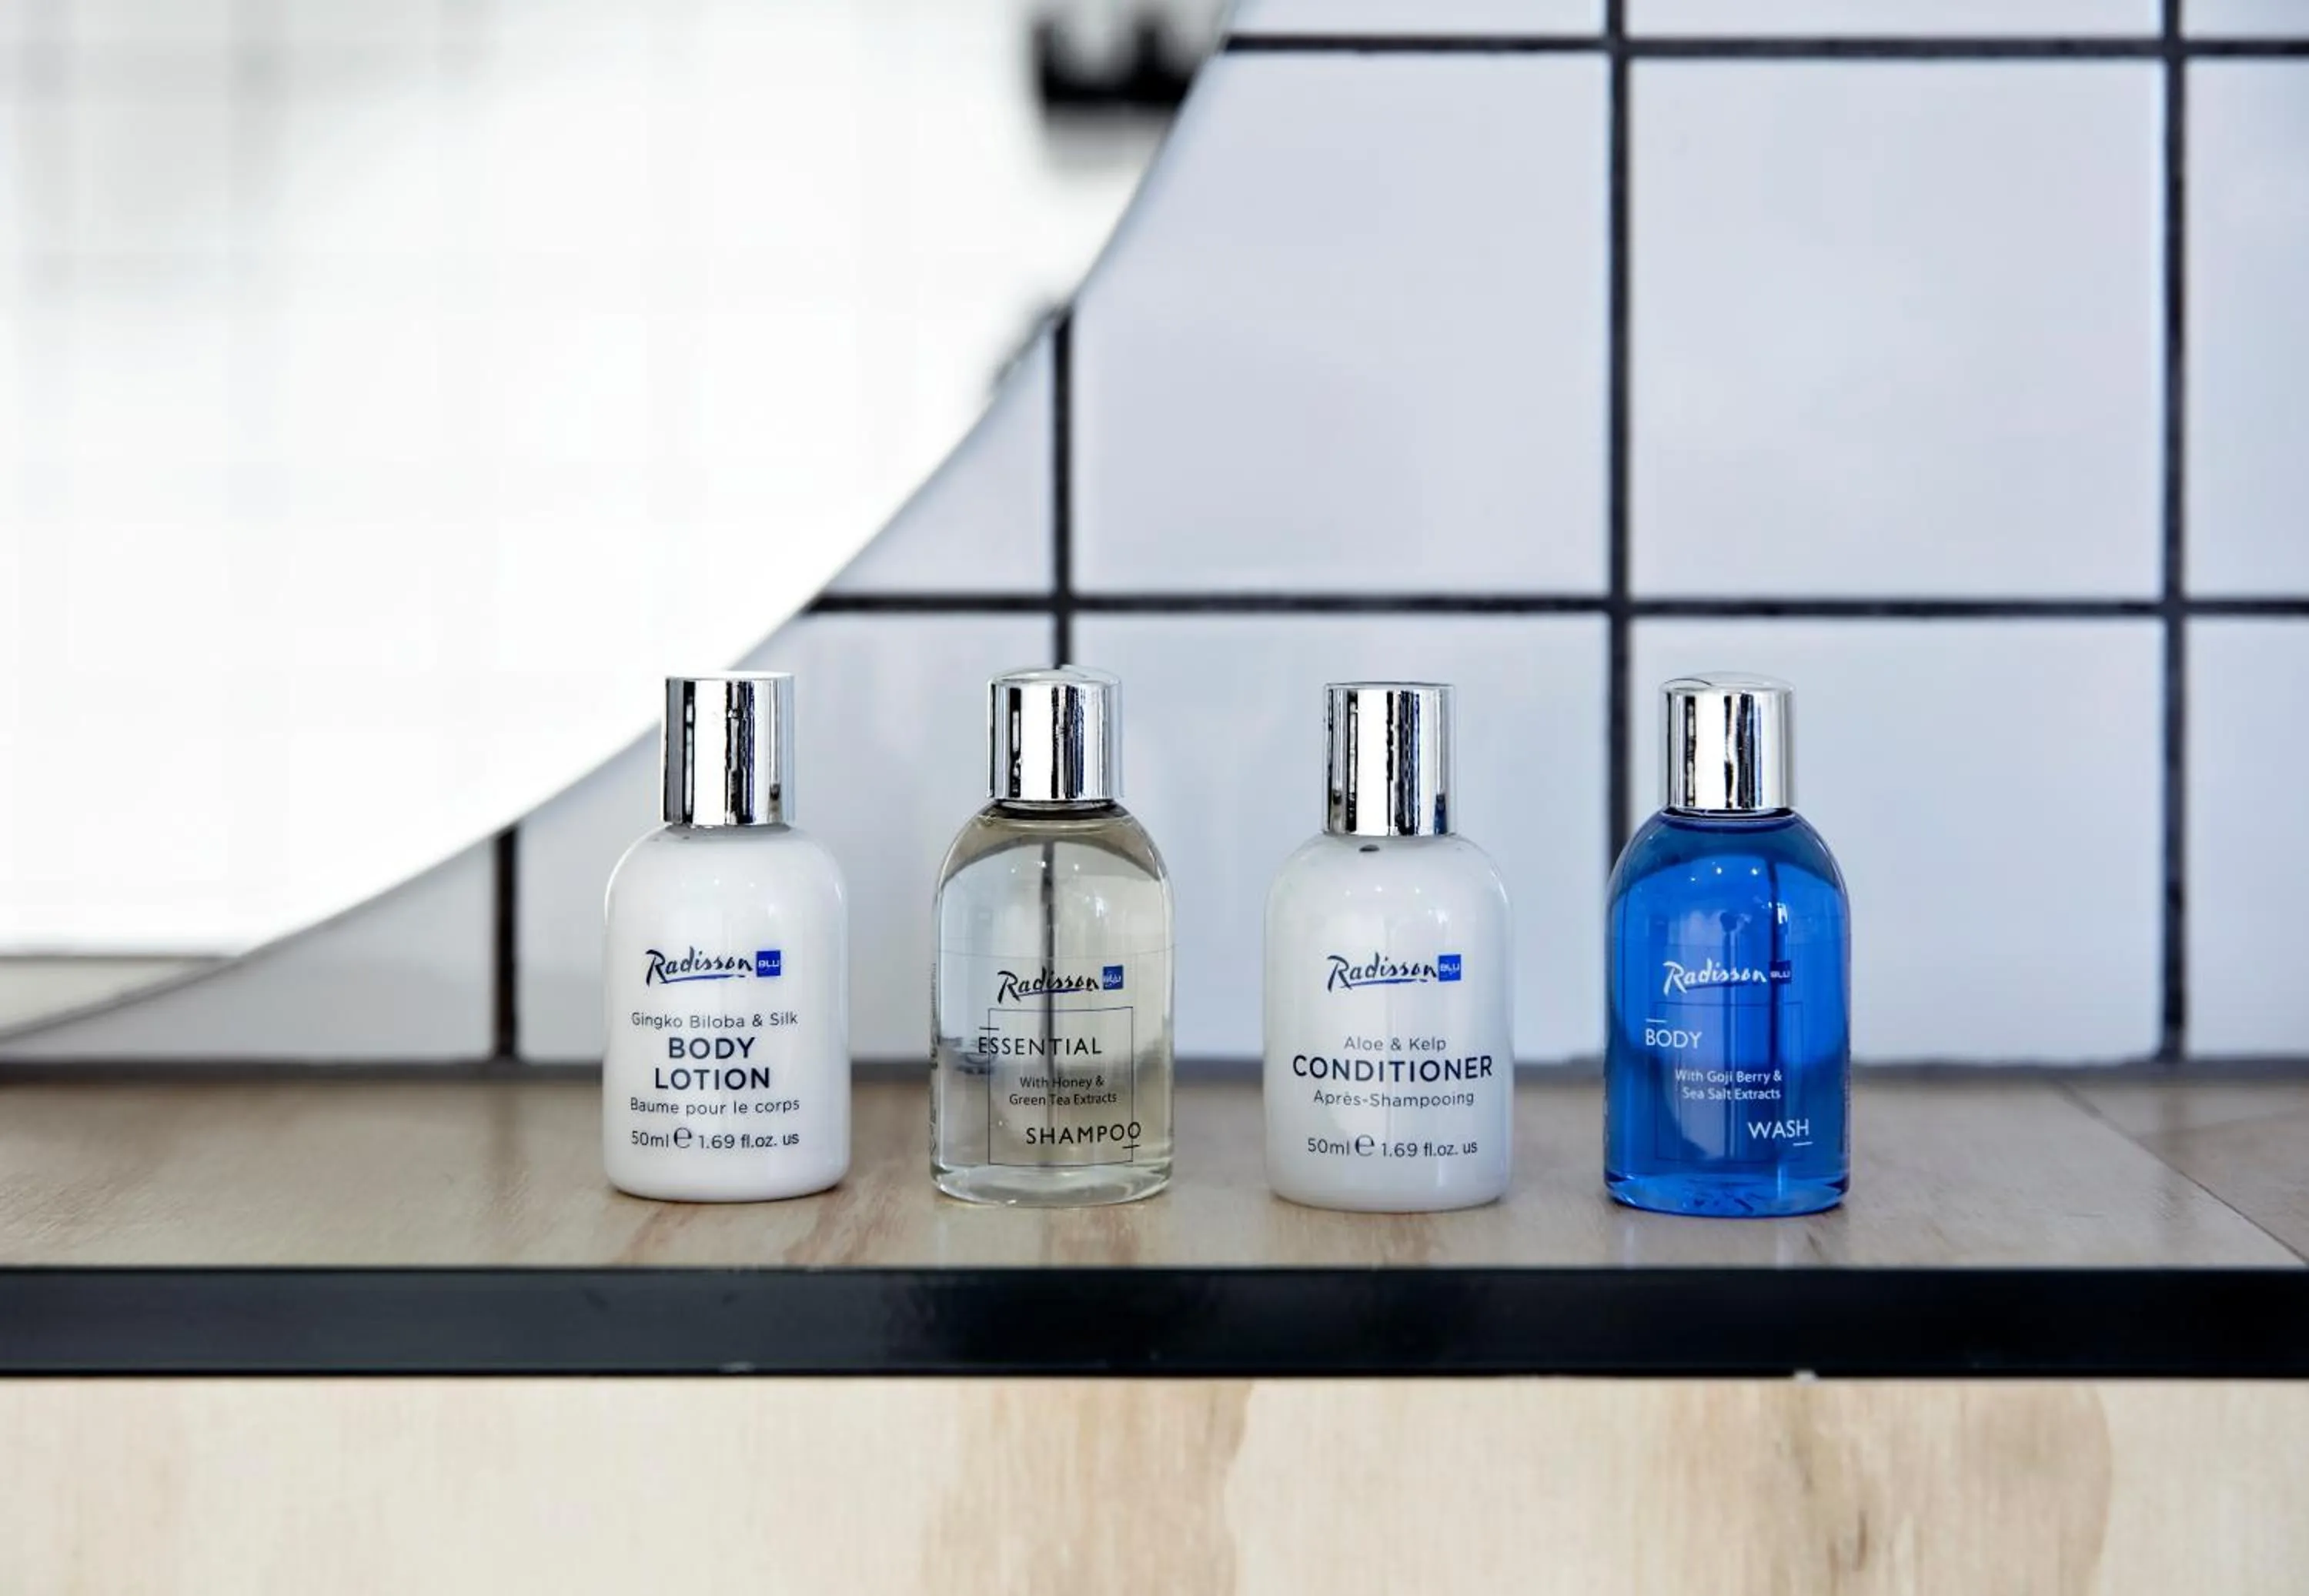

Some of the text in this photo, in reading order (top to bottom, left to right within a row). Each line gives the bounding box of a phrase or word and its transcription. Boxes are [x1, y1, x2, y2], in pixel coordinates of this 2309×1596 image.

[646, 946, 753, 986] Radisson
[1327, 952, 1437, 993] Radisson
[997, 967, 1099, 1003] Radisson
[1662, 958, 1766, 997] Radisson
[632, 1012, 798, 1029] Gingko Biloba & Silk
[669, 1037, 755, 1059] BODY
[978, 1037, 1102, 1056] ESSENTIAL
[1344, 1037, 1446, 1053] Aloe & Kelp
[1646, 1028, 1703, 1049] BODY
[656, 1067, 770, 1090] LOTION
[1293, 1055, 1492, 1083] CONDITIONER
[1676, 1069, 1782, 1085] With Goji Berry &
[1020, 1075, 1104, 1090] With Honey &
[1009, 1093, 1117, 1105] Green Tea Extracts
[1682, 1087, 1781, 1100] Sea Salt Extracts
[630, 1097, 800, 1116] Baume pour le corps
[1026, 1122, 1141, 1144] SHAMPOO
[1748, 1118, 1809, 1139] WASH
[632, 1130, 668, 1147] 50ml
[699, 1135, 734, 1148] 1.69
[1308, 1137, 1349, 1155] 50ml
[1382, 1143, 1417, 1157] 1.69
